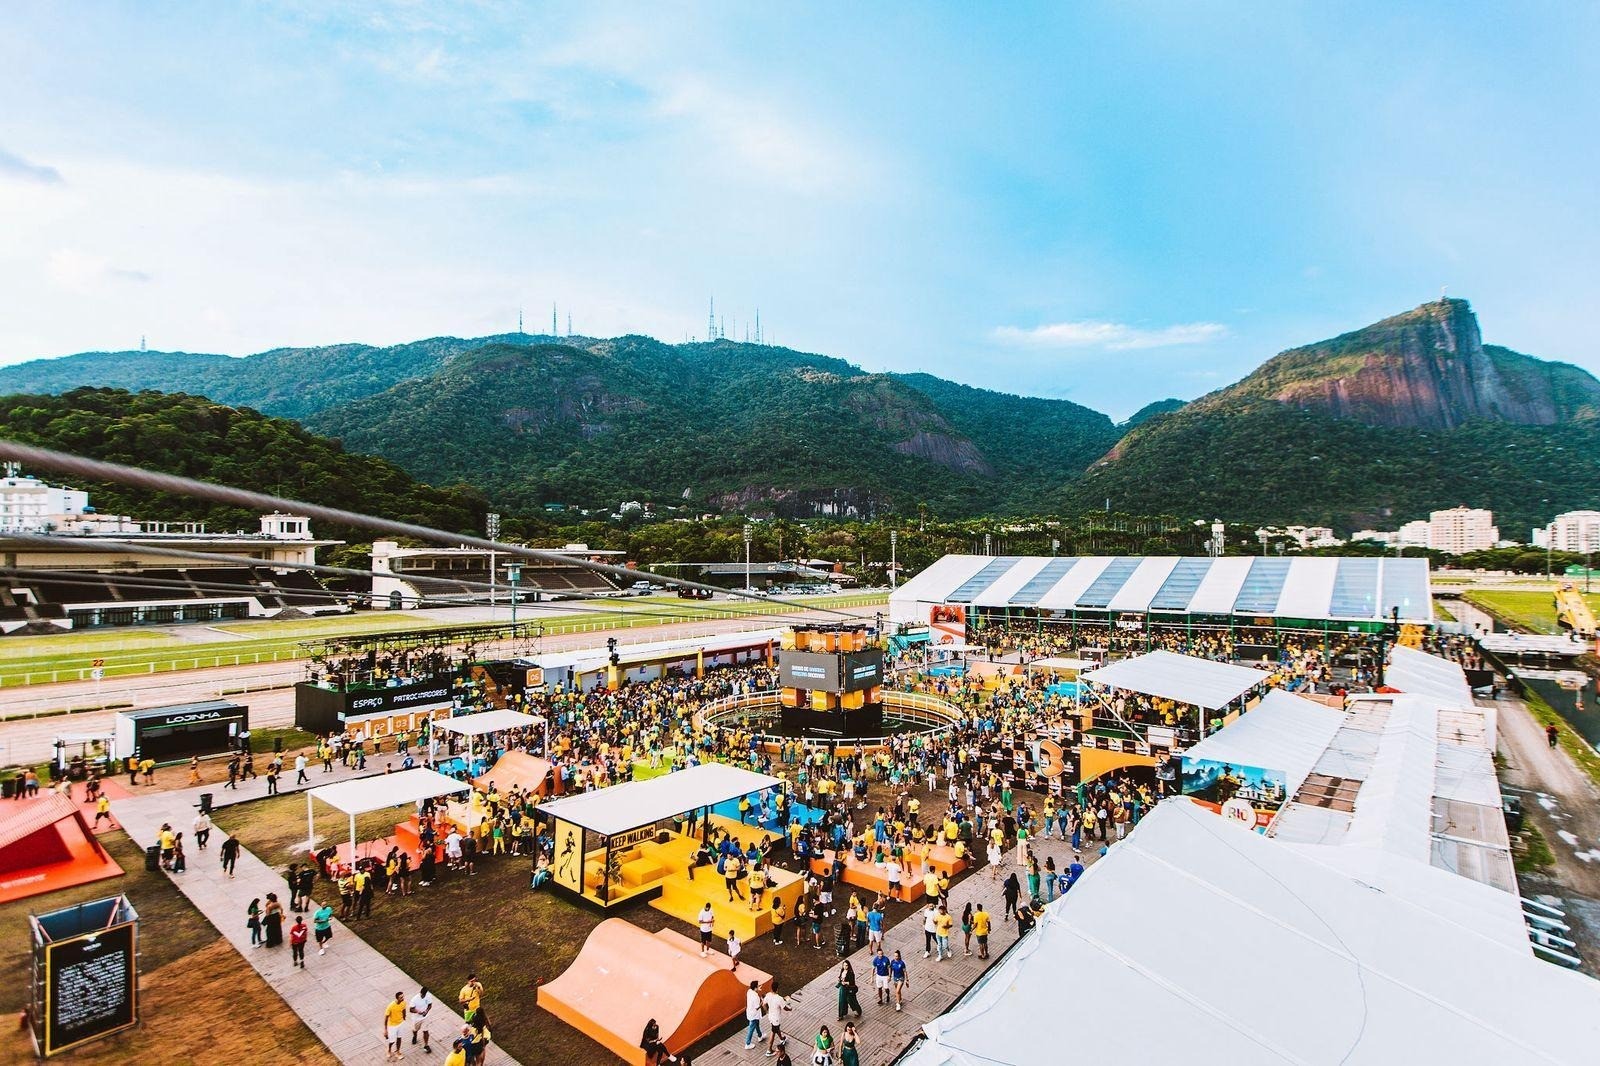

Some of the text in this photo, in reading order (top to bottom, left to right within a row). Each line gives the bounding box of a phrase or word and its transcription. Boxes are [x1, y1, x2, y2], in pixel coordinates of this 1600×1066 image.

[93, 659, 104, 667] 22
[353, 688, 448, 709] ESPAÇO PATROCINADORES
[165, 711, 221, 724] LOJINHA
[374, 723, 385, 731] 02
[396, 719, 407, 728] 03
[610, 827, 654, 849] KEEP WALKING
